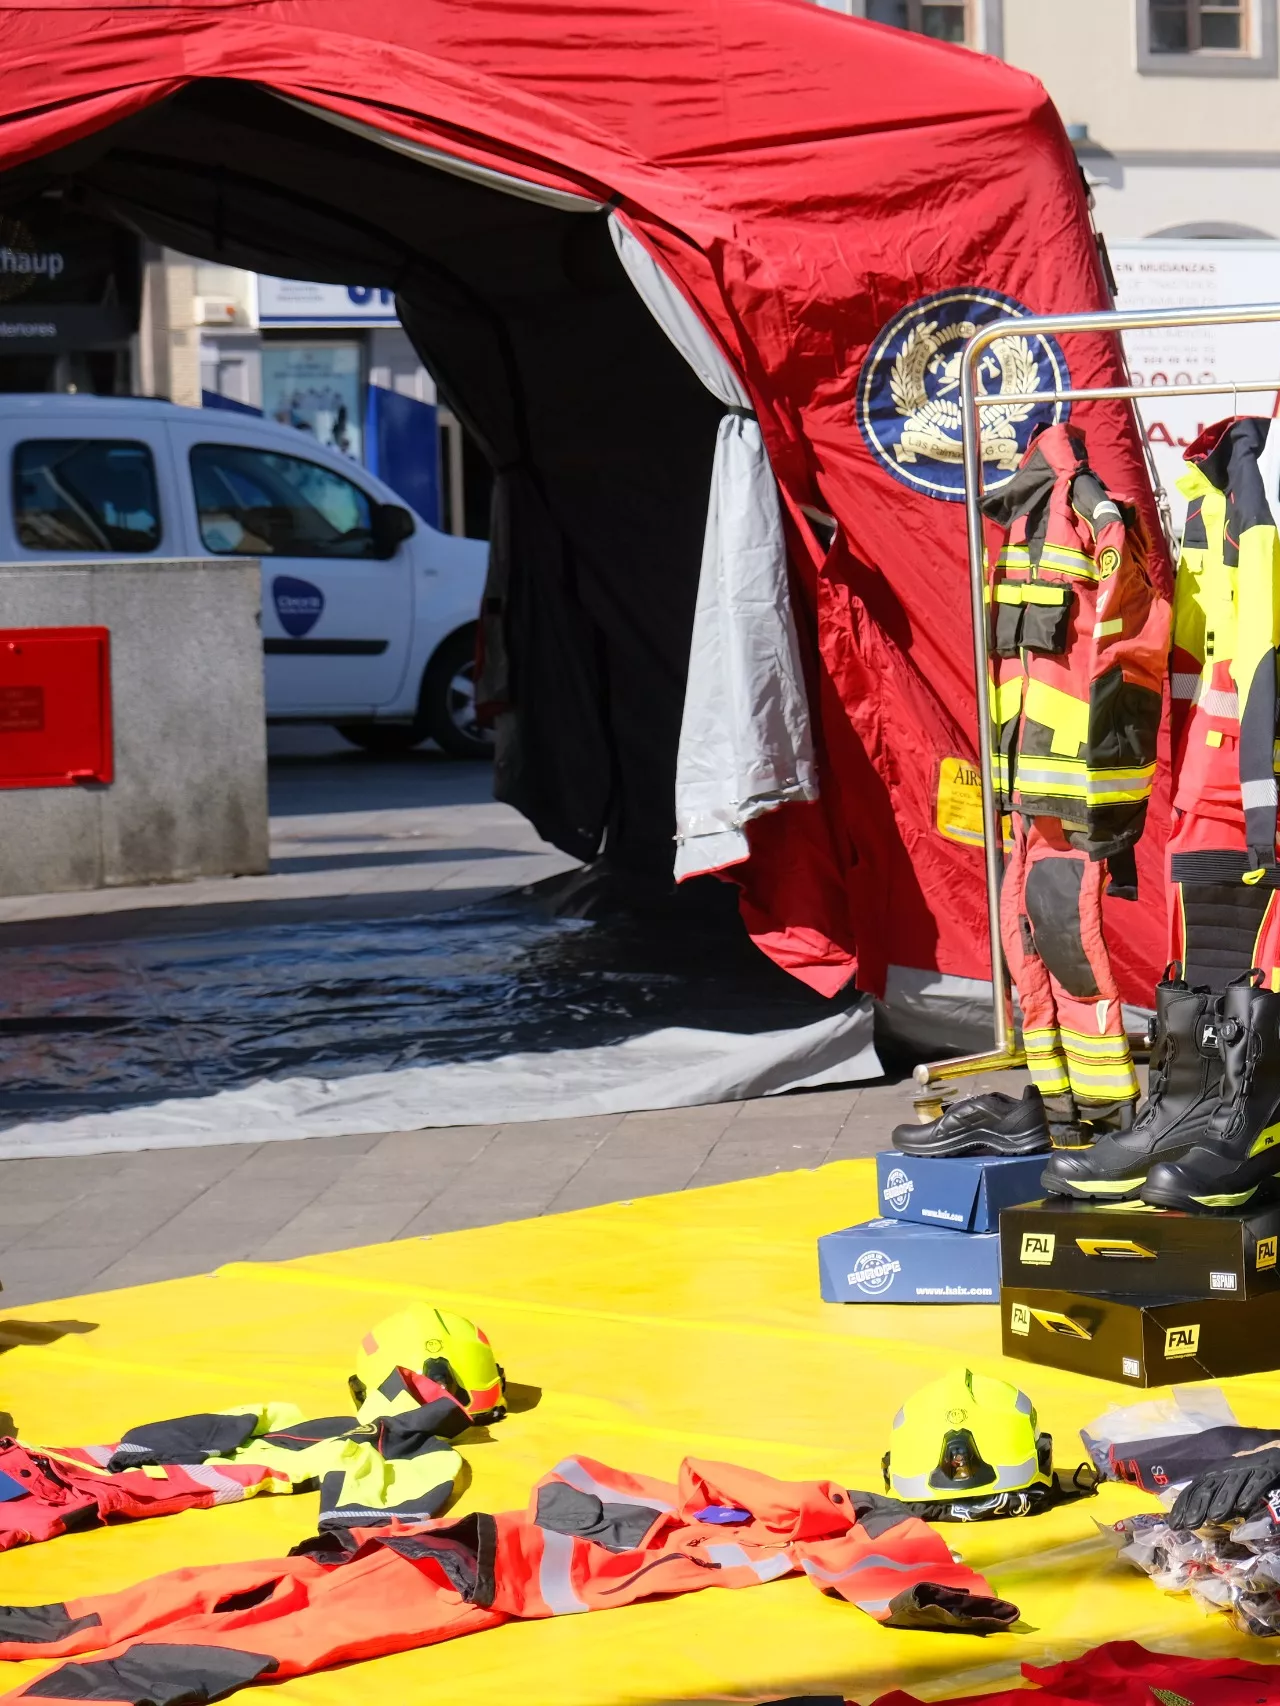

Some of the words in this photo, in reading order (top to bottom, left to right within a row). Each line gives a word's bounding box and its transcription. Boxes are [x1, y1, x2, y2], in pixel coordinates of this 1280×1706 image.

[0, 247, 64, 279] haup
[908, 436, 928, 450] Las
[883, 1180, 914, 1201] EUROPE
[921, 1208, 963, 1223] www.haix.com
[1025, 1238, 1050, 1253] FAL
[1258, 1242, 1275, 1258] FAL
[847, 1260, 901, 1285] EUROPE
[916, 1286, 993, 1296] www.haix.com
[1013, 1307, 1028, 1324] FAL
[1168, 1331, 1196, 1347] FAL
